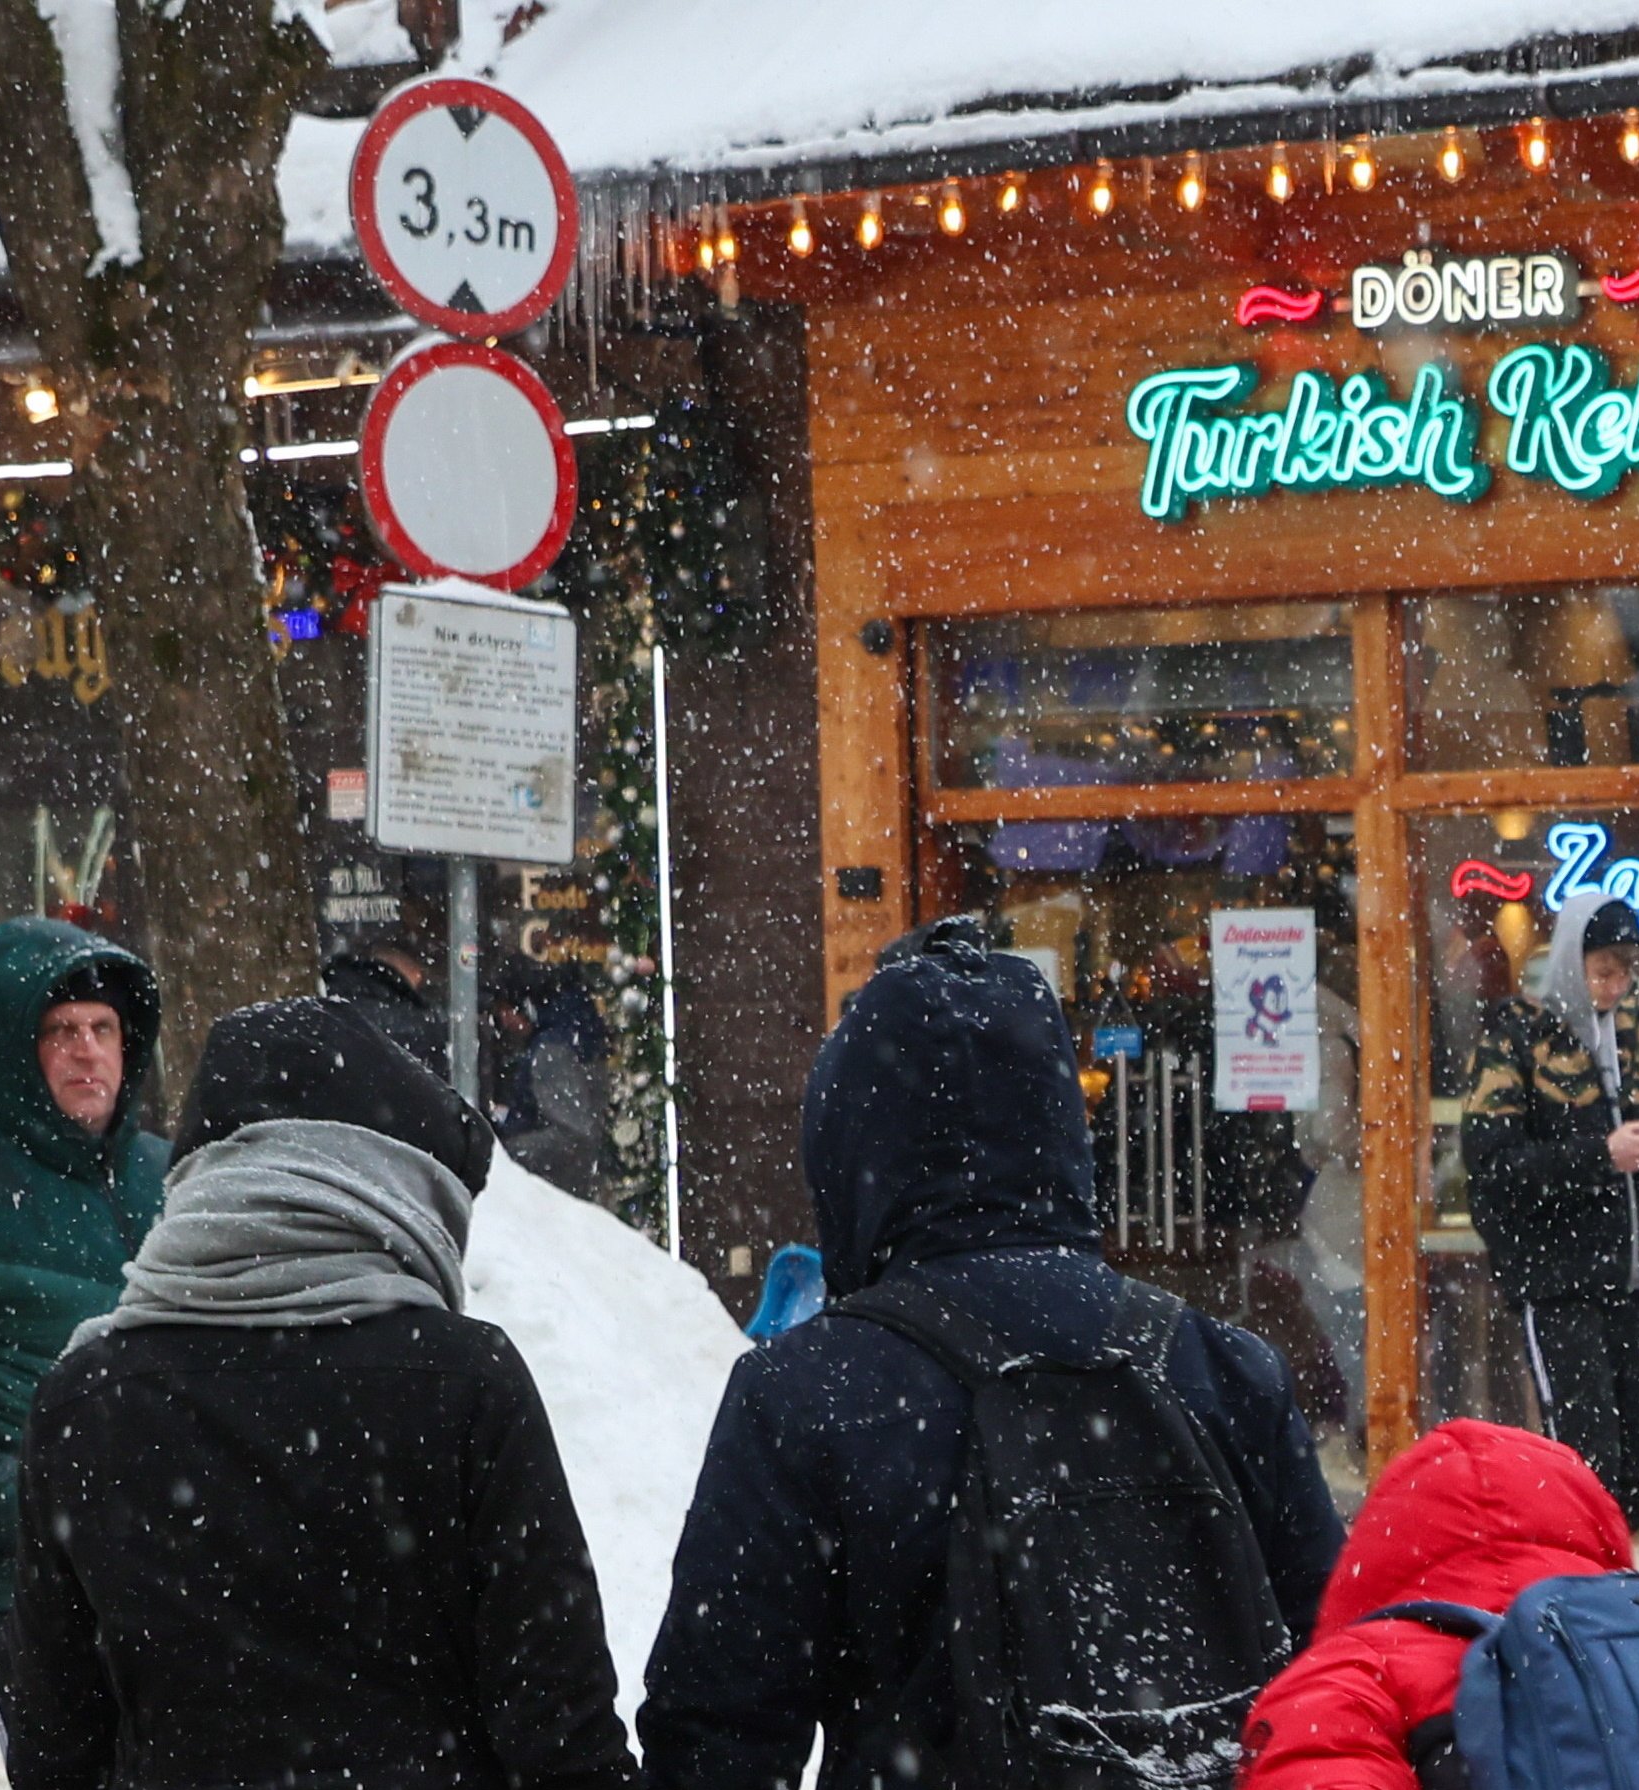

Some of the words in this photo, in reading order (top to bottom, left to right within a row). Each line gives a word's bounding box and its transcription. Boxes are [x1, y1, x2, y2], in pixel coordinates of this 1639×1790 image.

[1350, 252, 1567, 331] DÖNER
[1127, 363, 1475, 519] Turkish
[435, 626, 460, 643] Nie
